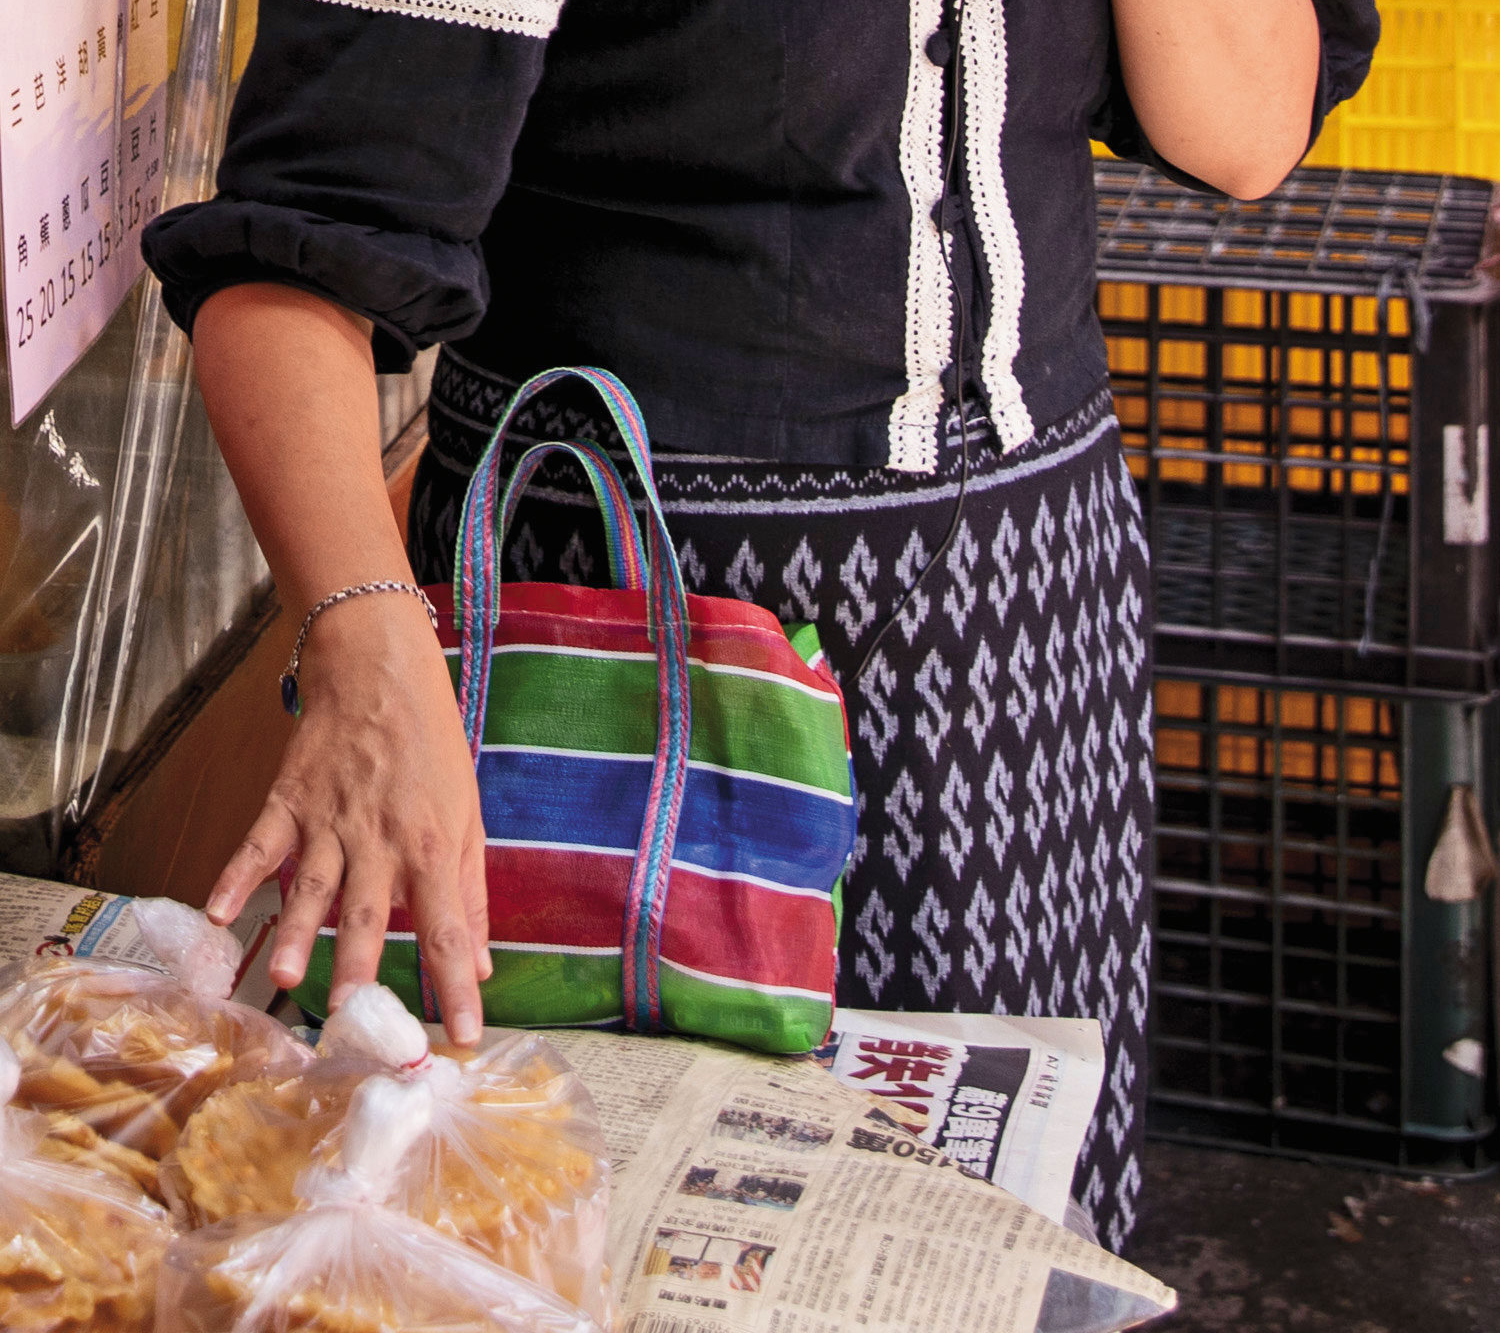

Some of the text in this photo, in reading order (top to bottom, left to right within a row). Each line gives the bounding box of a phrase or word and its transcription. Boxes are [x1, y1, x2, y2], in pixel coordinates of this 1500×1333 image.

[127, 186, 142, 231] 15
[80, 240, 95, 287] 15
[98, 221, 111, 268] 15
[38, 278, 56, 327] 20
[60, 259, 76, 307] 15
[16, 298, 35, 349] 25
[1029, 1054, 1060, 1110] A7 社會新聞
[657, 1288, 727, 1310] 重點新聞
